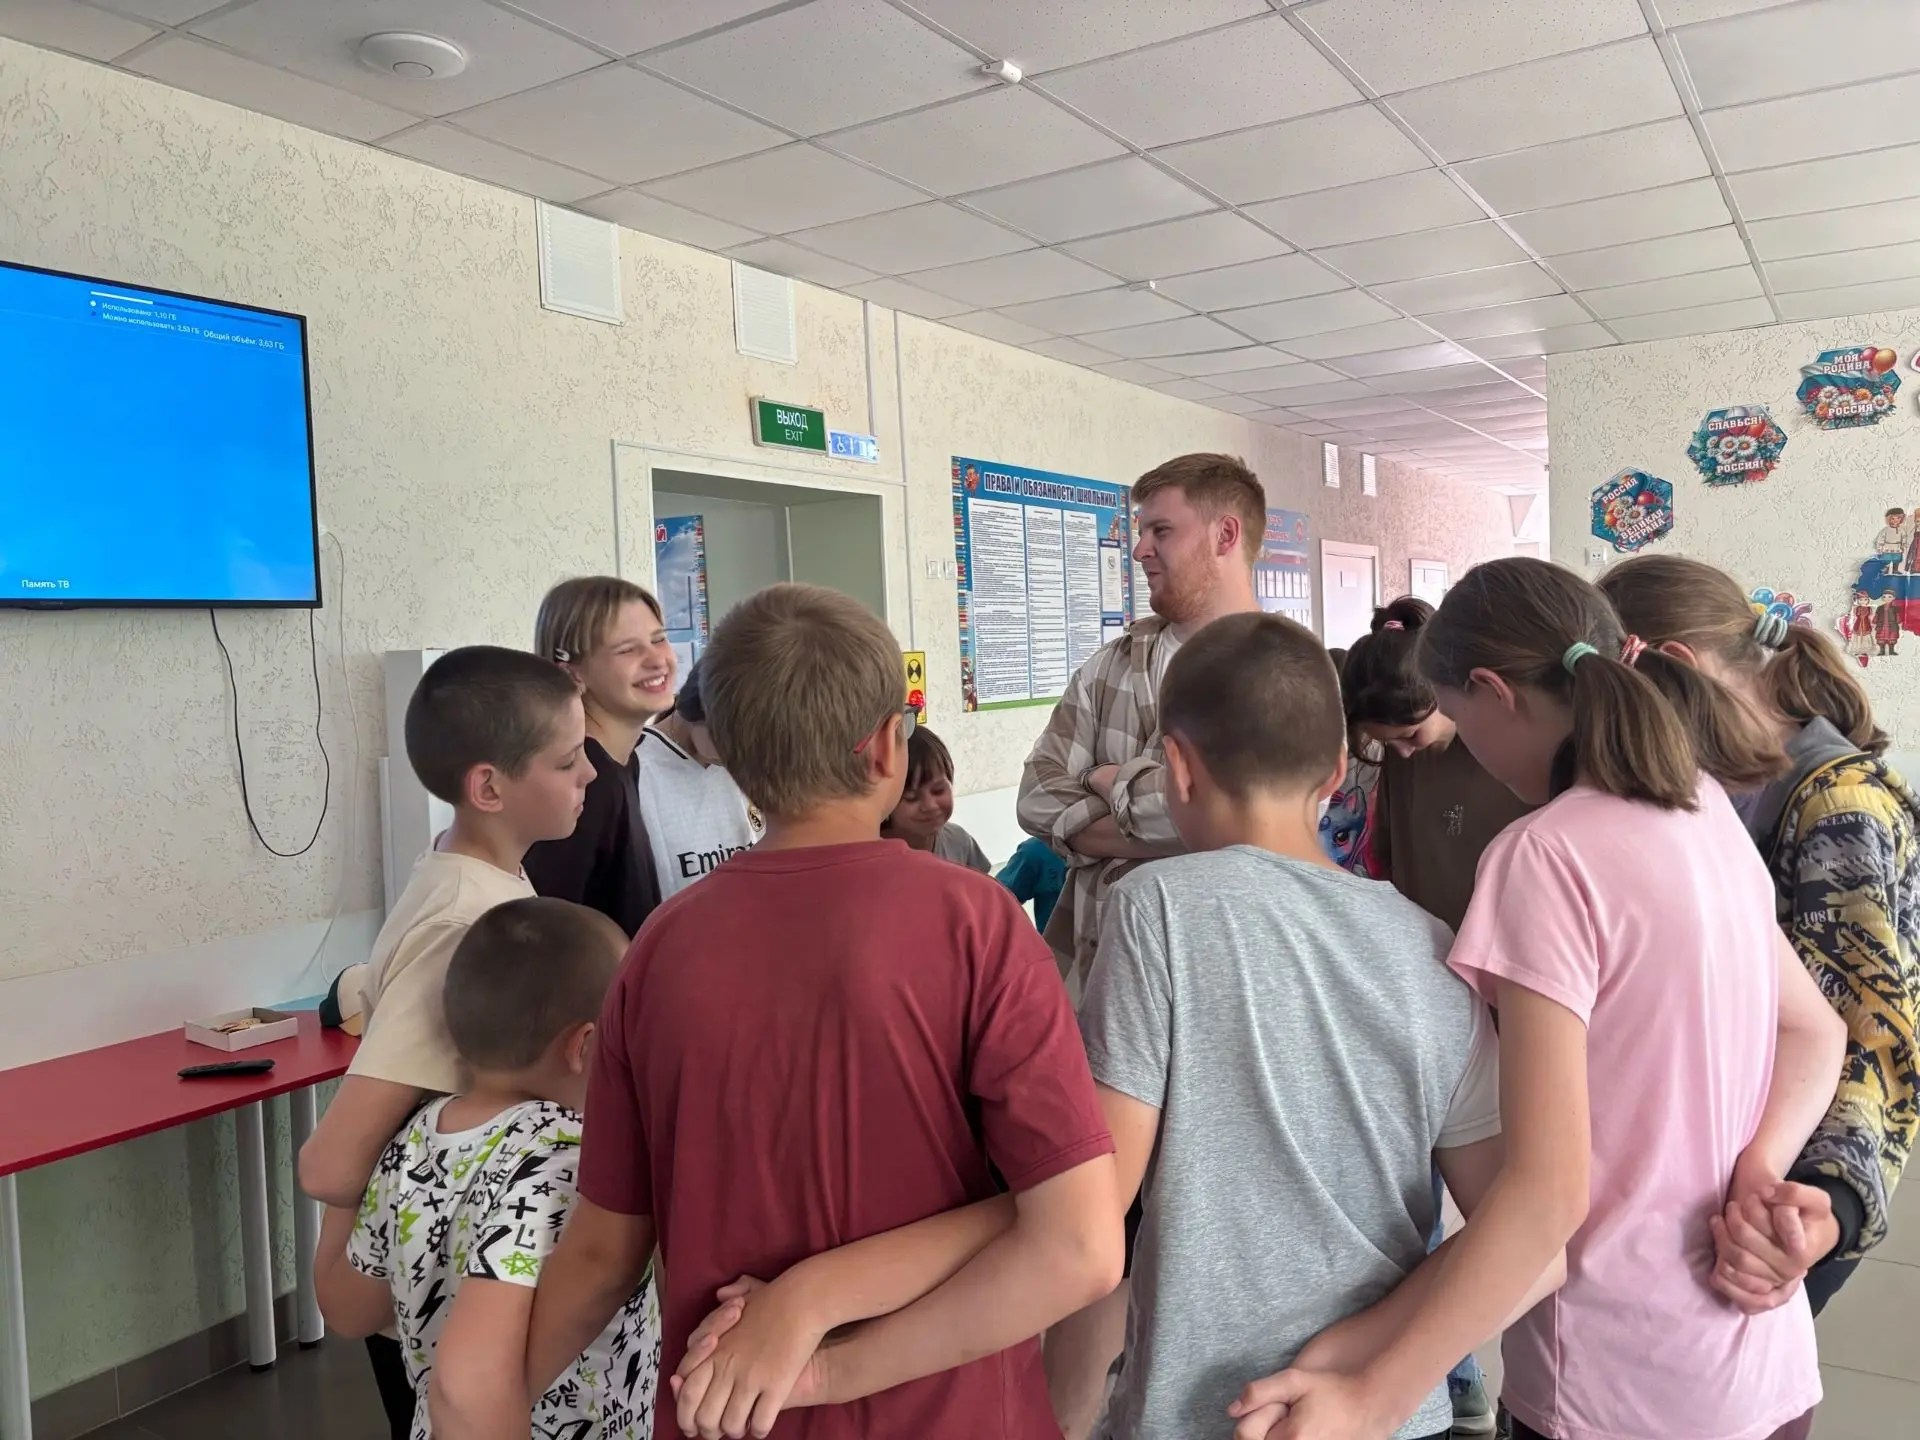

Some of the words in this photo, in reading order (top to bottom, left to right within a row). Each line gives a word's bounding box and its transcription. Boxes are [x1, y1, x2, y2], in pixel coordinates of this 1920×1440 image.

[102, 312, 128, 323] Можно
[177, 324, 190, 333] 2,53
[191, 326, 200, 334] ГБ
[154, 311, 167, 319] 1,10
[203, 330, 230, 341] Общий
[258, 338, 274, 348] 3,63
[274, 340, 285, 350] ГБ
[1834, 353, 1860, 365] МОЯ
[1828, 403, 1874, 417] РОССИЯ
[776, 409, 808, 431] ВЫХОД
[1708, 415, 1763, 432] СЛАВЬСЯ!
[785, 429, 803, 442] EXIT
[1716, 459, 1764, 475] РОССИЯ!
[984, 472, 1013, 493] ПРАВА
[1014, 477, 1021, 496] И
[1022, 478, 1076, 504] ОБЯЗАННОСТИ
[1076, 487, 1119, 509] ШКОЛЬНИКА
[1602, 477, 1639, 504] РОССИЯ
[1620, 508, 1664, 540] ВЕЛИКАЯ
[1628, 518, 1666, 543] СТРАНА
[21, 579, 56, 589] Память
[57, 579, 70, 589] ТВ
